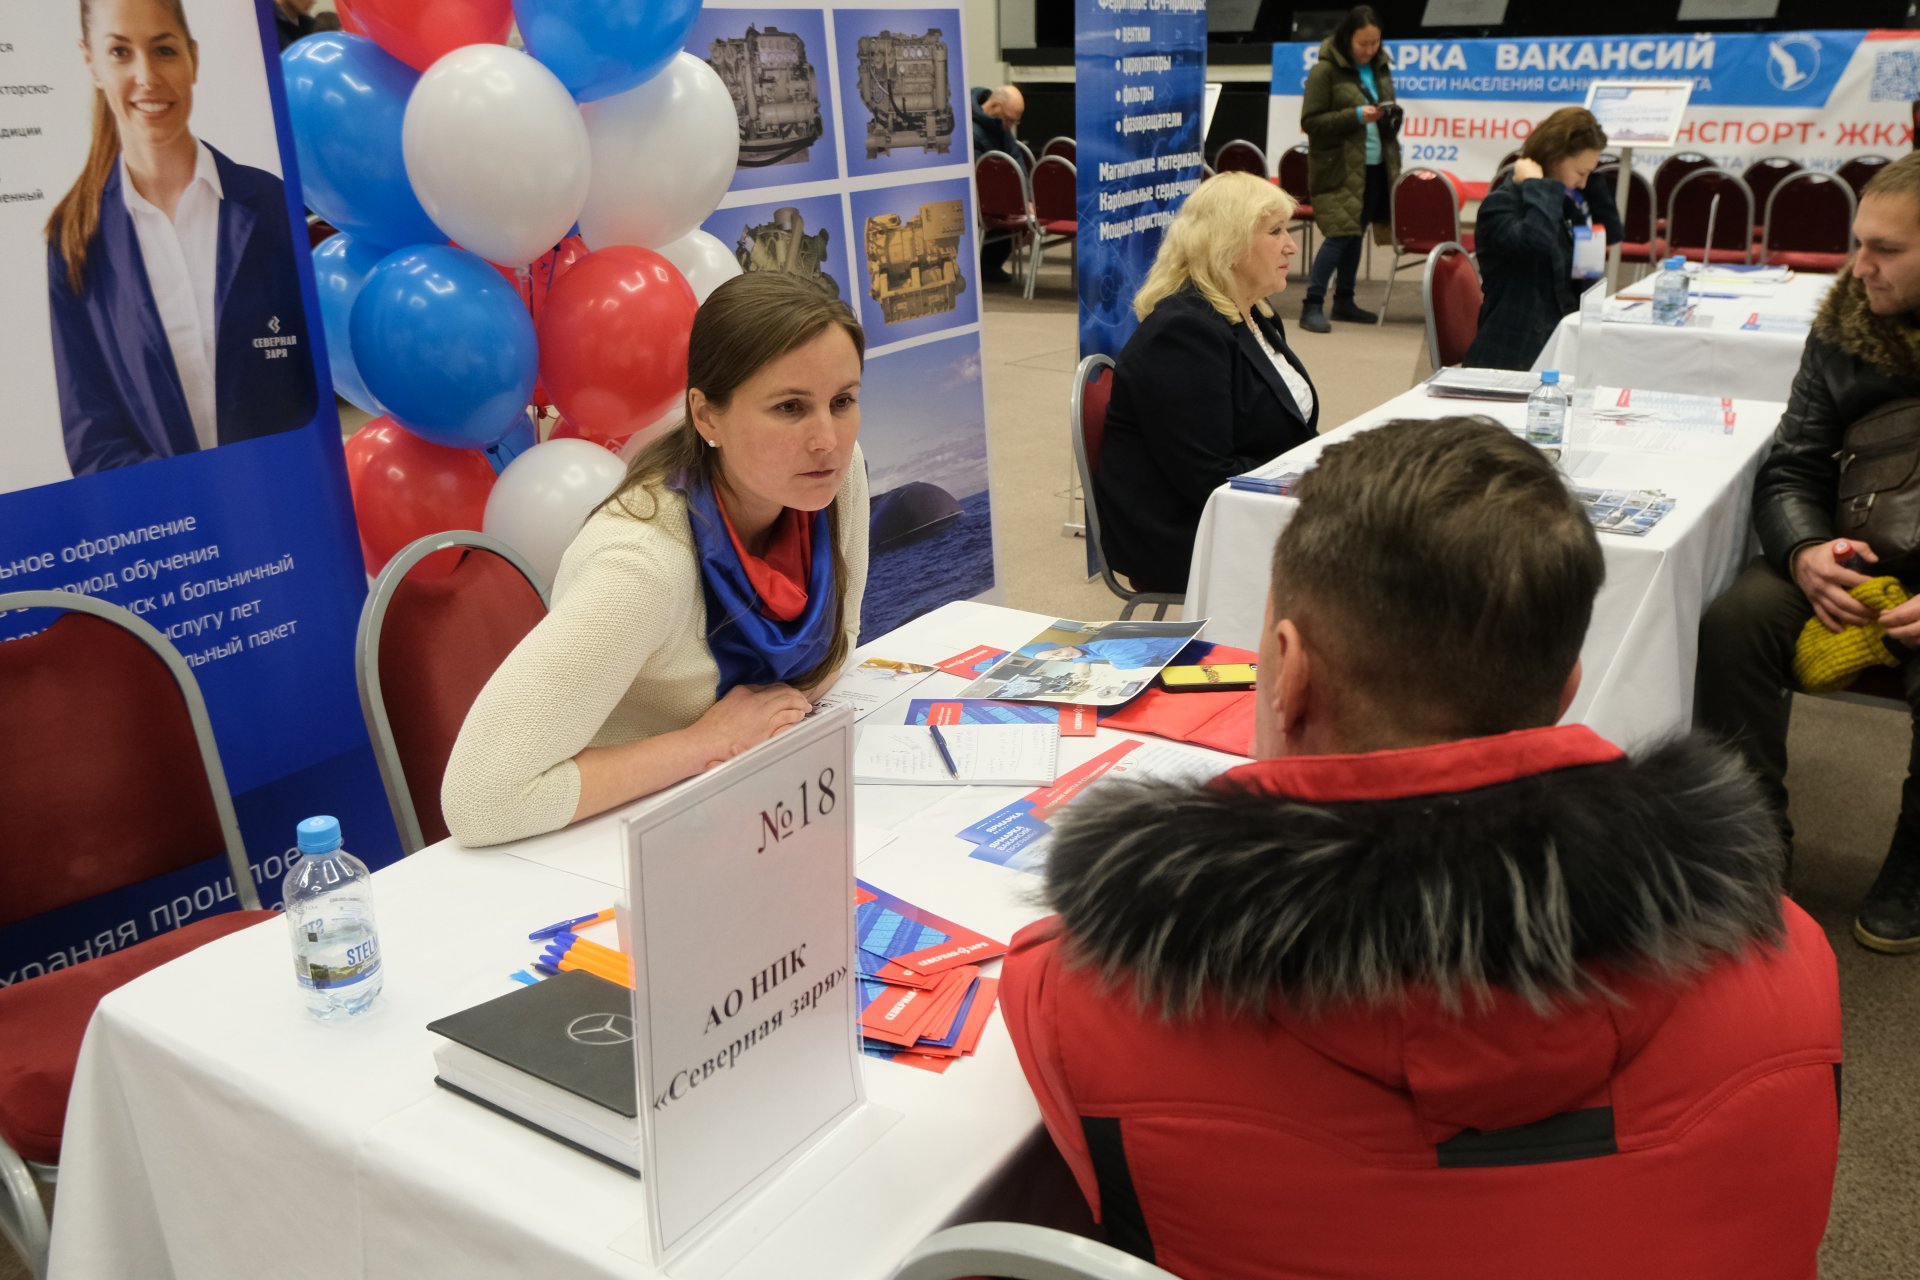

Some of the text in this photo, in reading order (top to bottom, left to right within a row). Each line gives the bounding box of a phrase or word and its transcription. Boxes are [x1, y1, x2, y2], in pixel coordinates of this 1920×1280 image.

[1303, 32, 1716, 71] ЯРКА ВАКАНСИЙ
[1450, 77, 1544, 92] НАСЕЛЕНИЯ
[1411, 145, 1458, 160] 2022
[252, 335, 298, 348] СЕВЕРНАЯ
[265, 348, 288, 360] ЗАРЯ
[61, 515, 197, 563] оформление
[121, 544, 220, 582] обучения
[161, 591, 175, 607] и
[180, 553, 295, 602] больничный
[230, 600, 262, 621] лет
[248, 620, 298, 649] пакет
[757, 767, 837, 854] №18
[917, 941, 990, 966] СЕВЕРНАЯ ЗАРЯ
[703, 942, 807, 1035] АО НПК
[884, 989, 918, 1021] СЕВЕРНАЯ
[653, 965, 848, 1111] «Северная заря»
